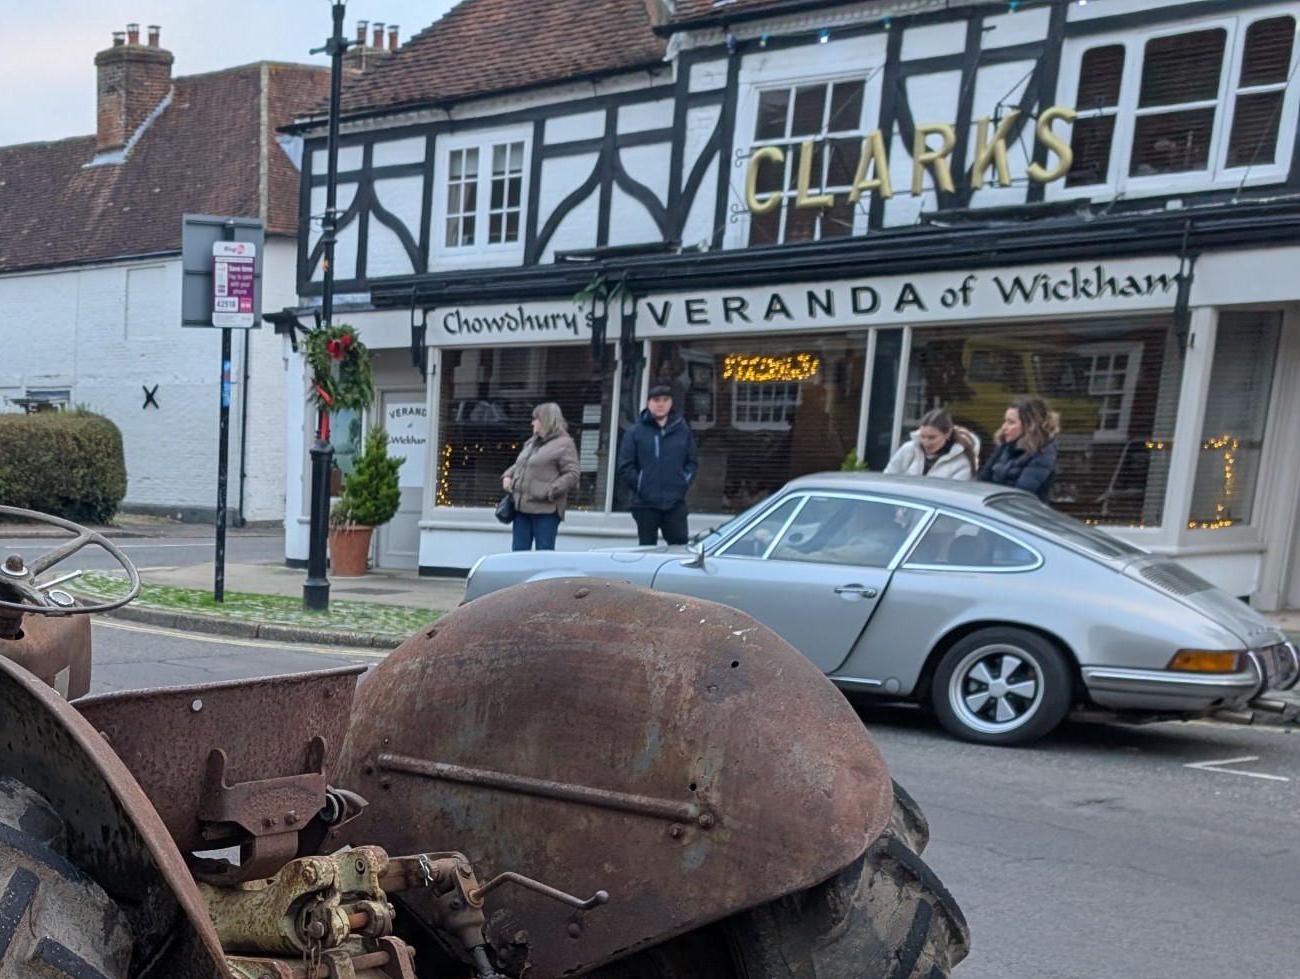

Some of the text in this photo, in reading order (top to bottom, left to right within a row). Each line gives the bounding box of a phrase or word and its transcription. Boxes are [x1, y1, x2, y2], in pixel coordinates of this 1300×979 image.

[746, 106, 1077, 214] CLARKS
[646, 265, 1184, 328] VERANDA of Wickham
